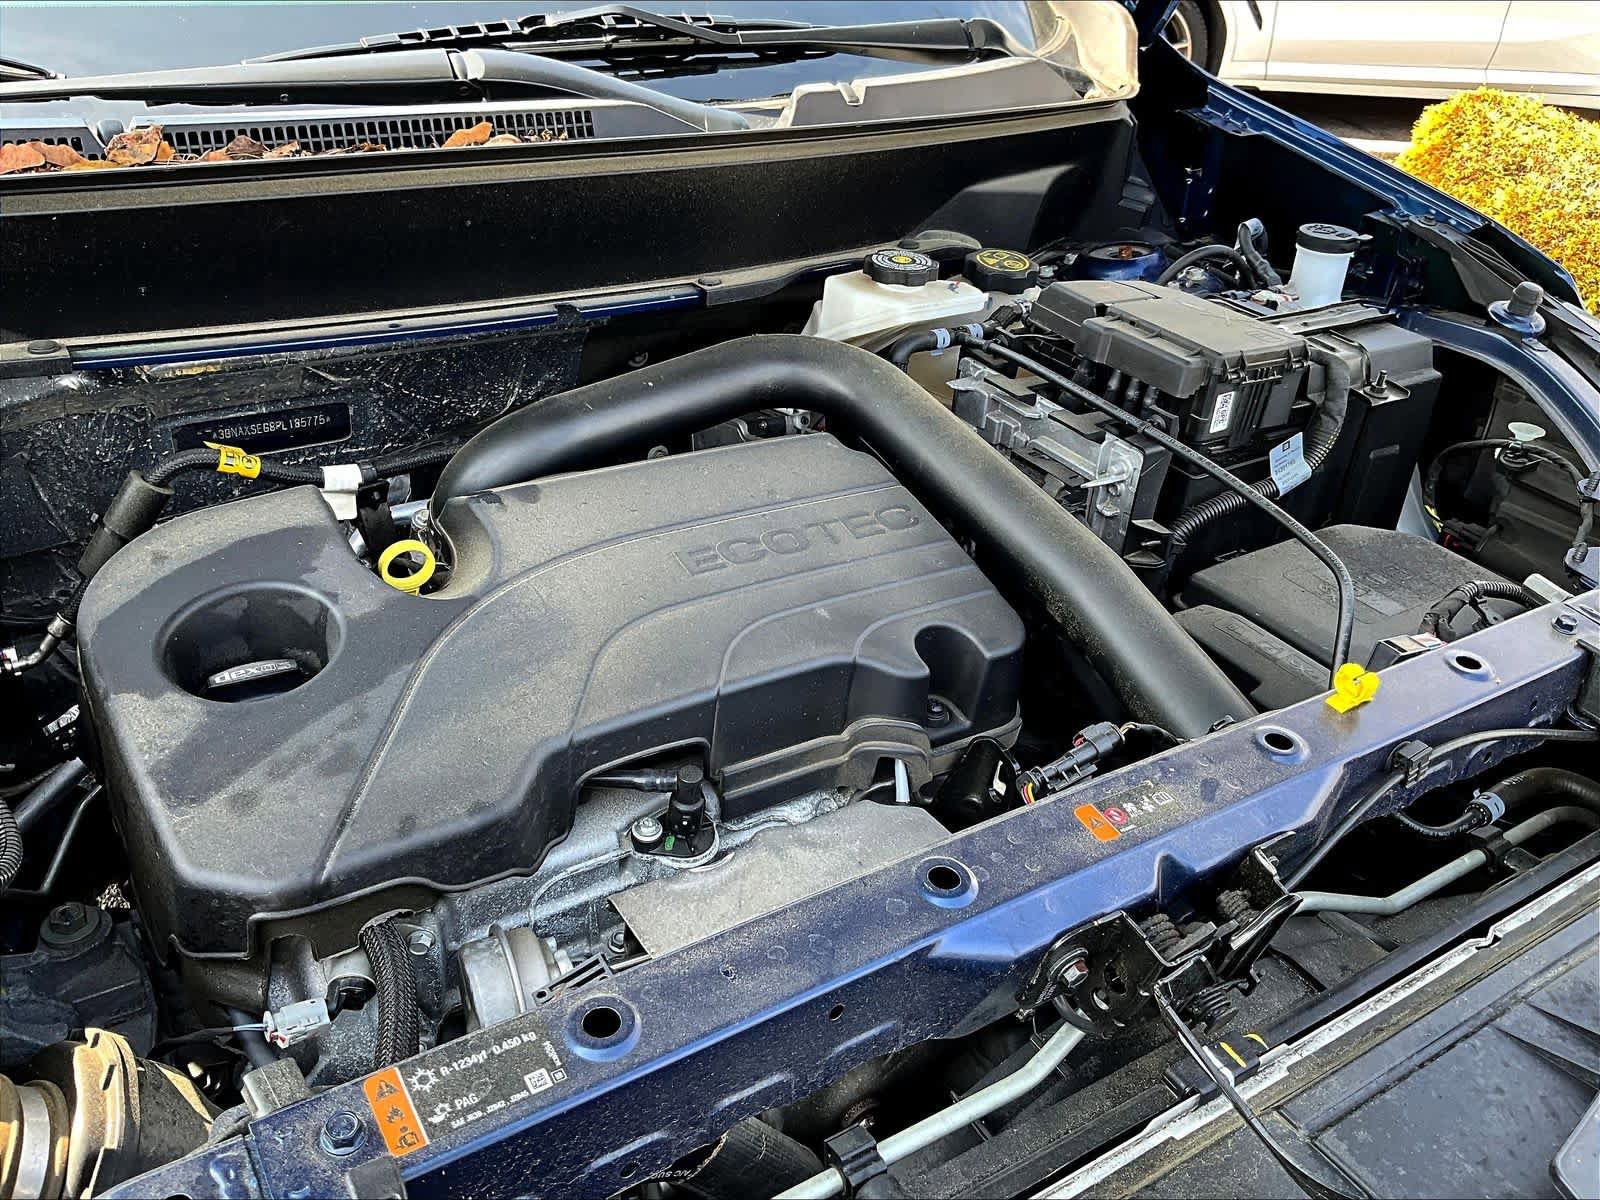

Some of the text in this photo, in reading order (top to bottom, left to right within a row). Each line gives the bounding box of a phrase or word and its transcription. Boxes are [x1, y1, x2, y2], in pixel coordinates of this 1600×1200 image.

[671, 504, 919, 576] ECOTEC
[214, 661, 293, 684] dexos
[440, 1050, 488, 1076] R-1234yf
[492, 1036, 521, 1055] 0.450
[521, 1031, 537, 1042] kg
[454, 1093, 480, 1110] PAG
